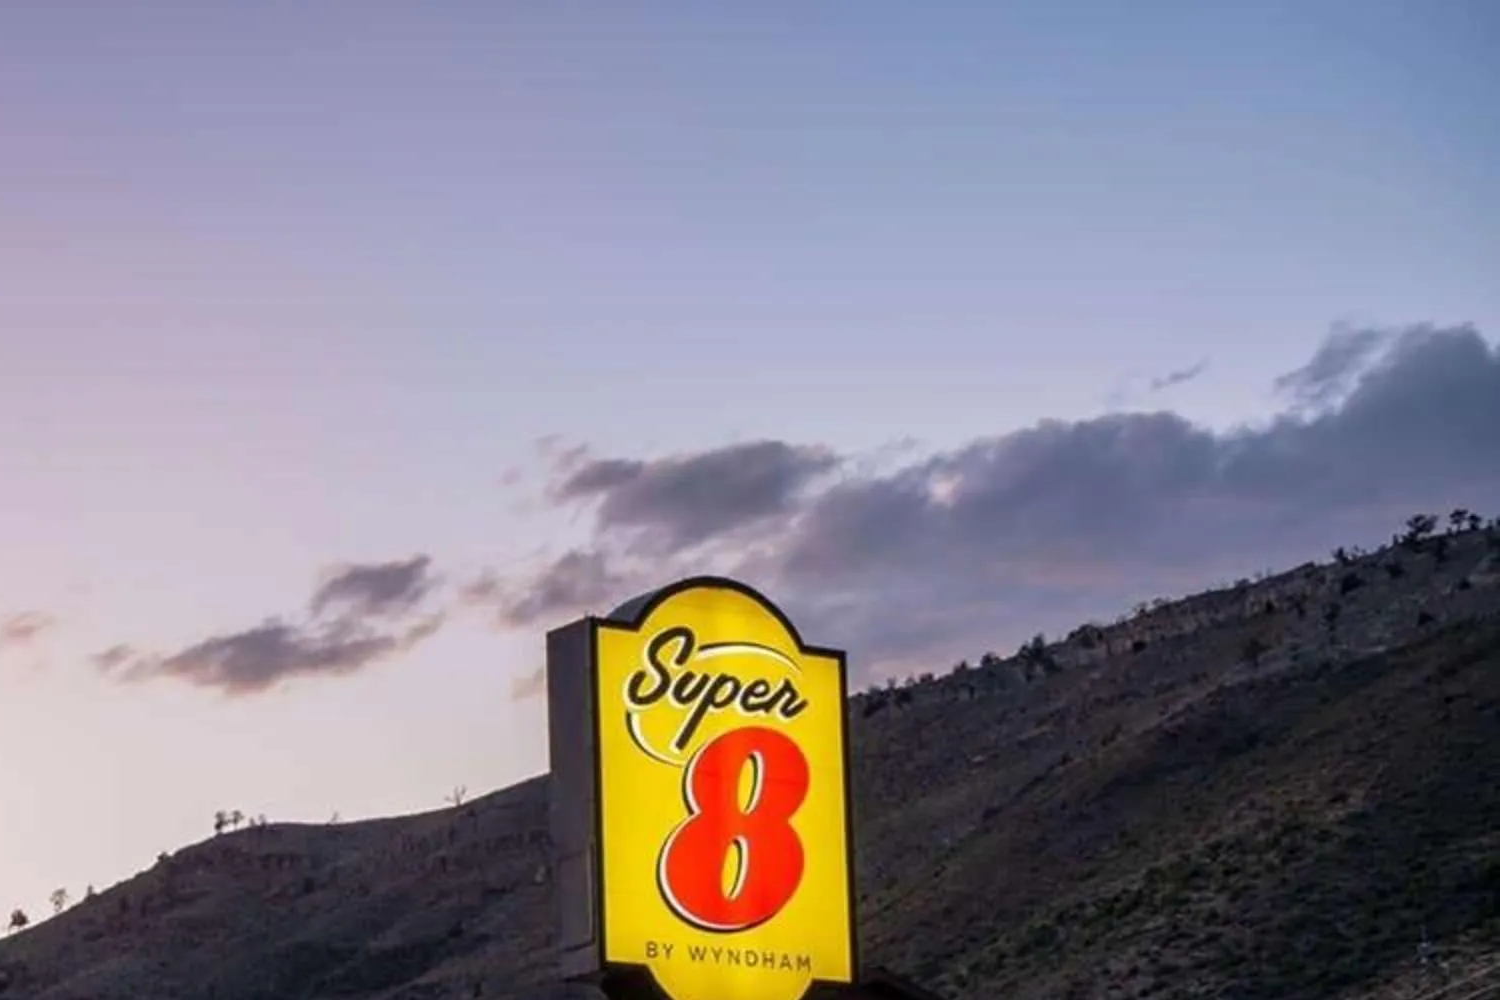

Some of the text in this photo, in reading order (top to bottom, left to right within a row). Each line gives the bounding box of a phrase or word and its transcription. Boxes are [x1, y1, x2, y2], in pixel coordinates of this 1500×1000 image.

[627, 627, 807, 751] Super
[656, 726, 810, 933] 8
[645, 941, 812, 973] BY WYNDHAM
